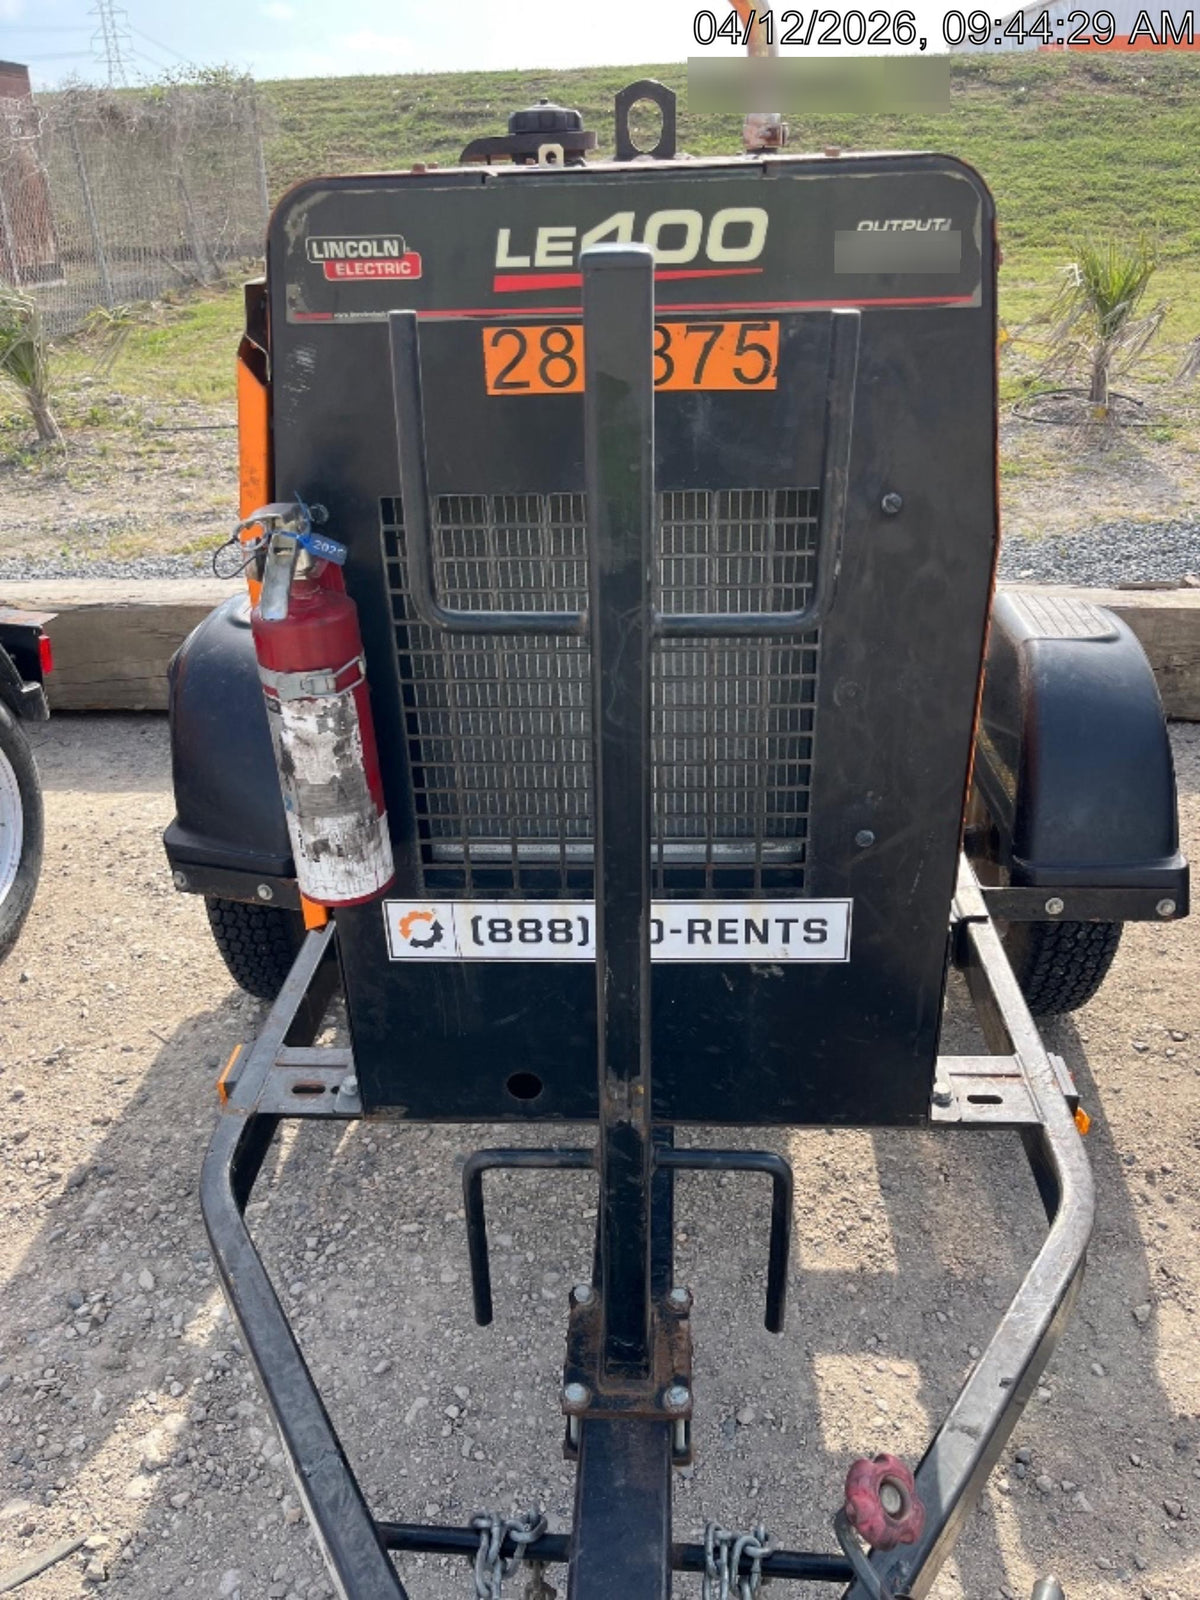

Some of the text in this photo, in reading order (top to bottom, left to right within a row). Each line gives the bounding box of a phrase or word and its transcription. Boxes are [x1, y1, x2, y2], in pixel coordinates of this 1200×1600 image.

[311, 240, 400, 258] LINCOLN
[495, 207, 769, 268] LE400
[335, 261, 412, 276] ELECTRIC
[490, 323, 772, 390] 2875
[470, 915, 829, 947] (888) -RENTS
